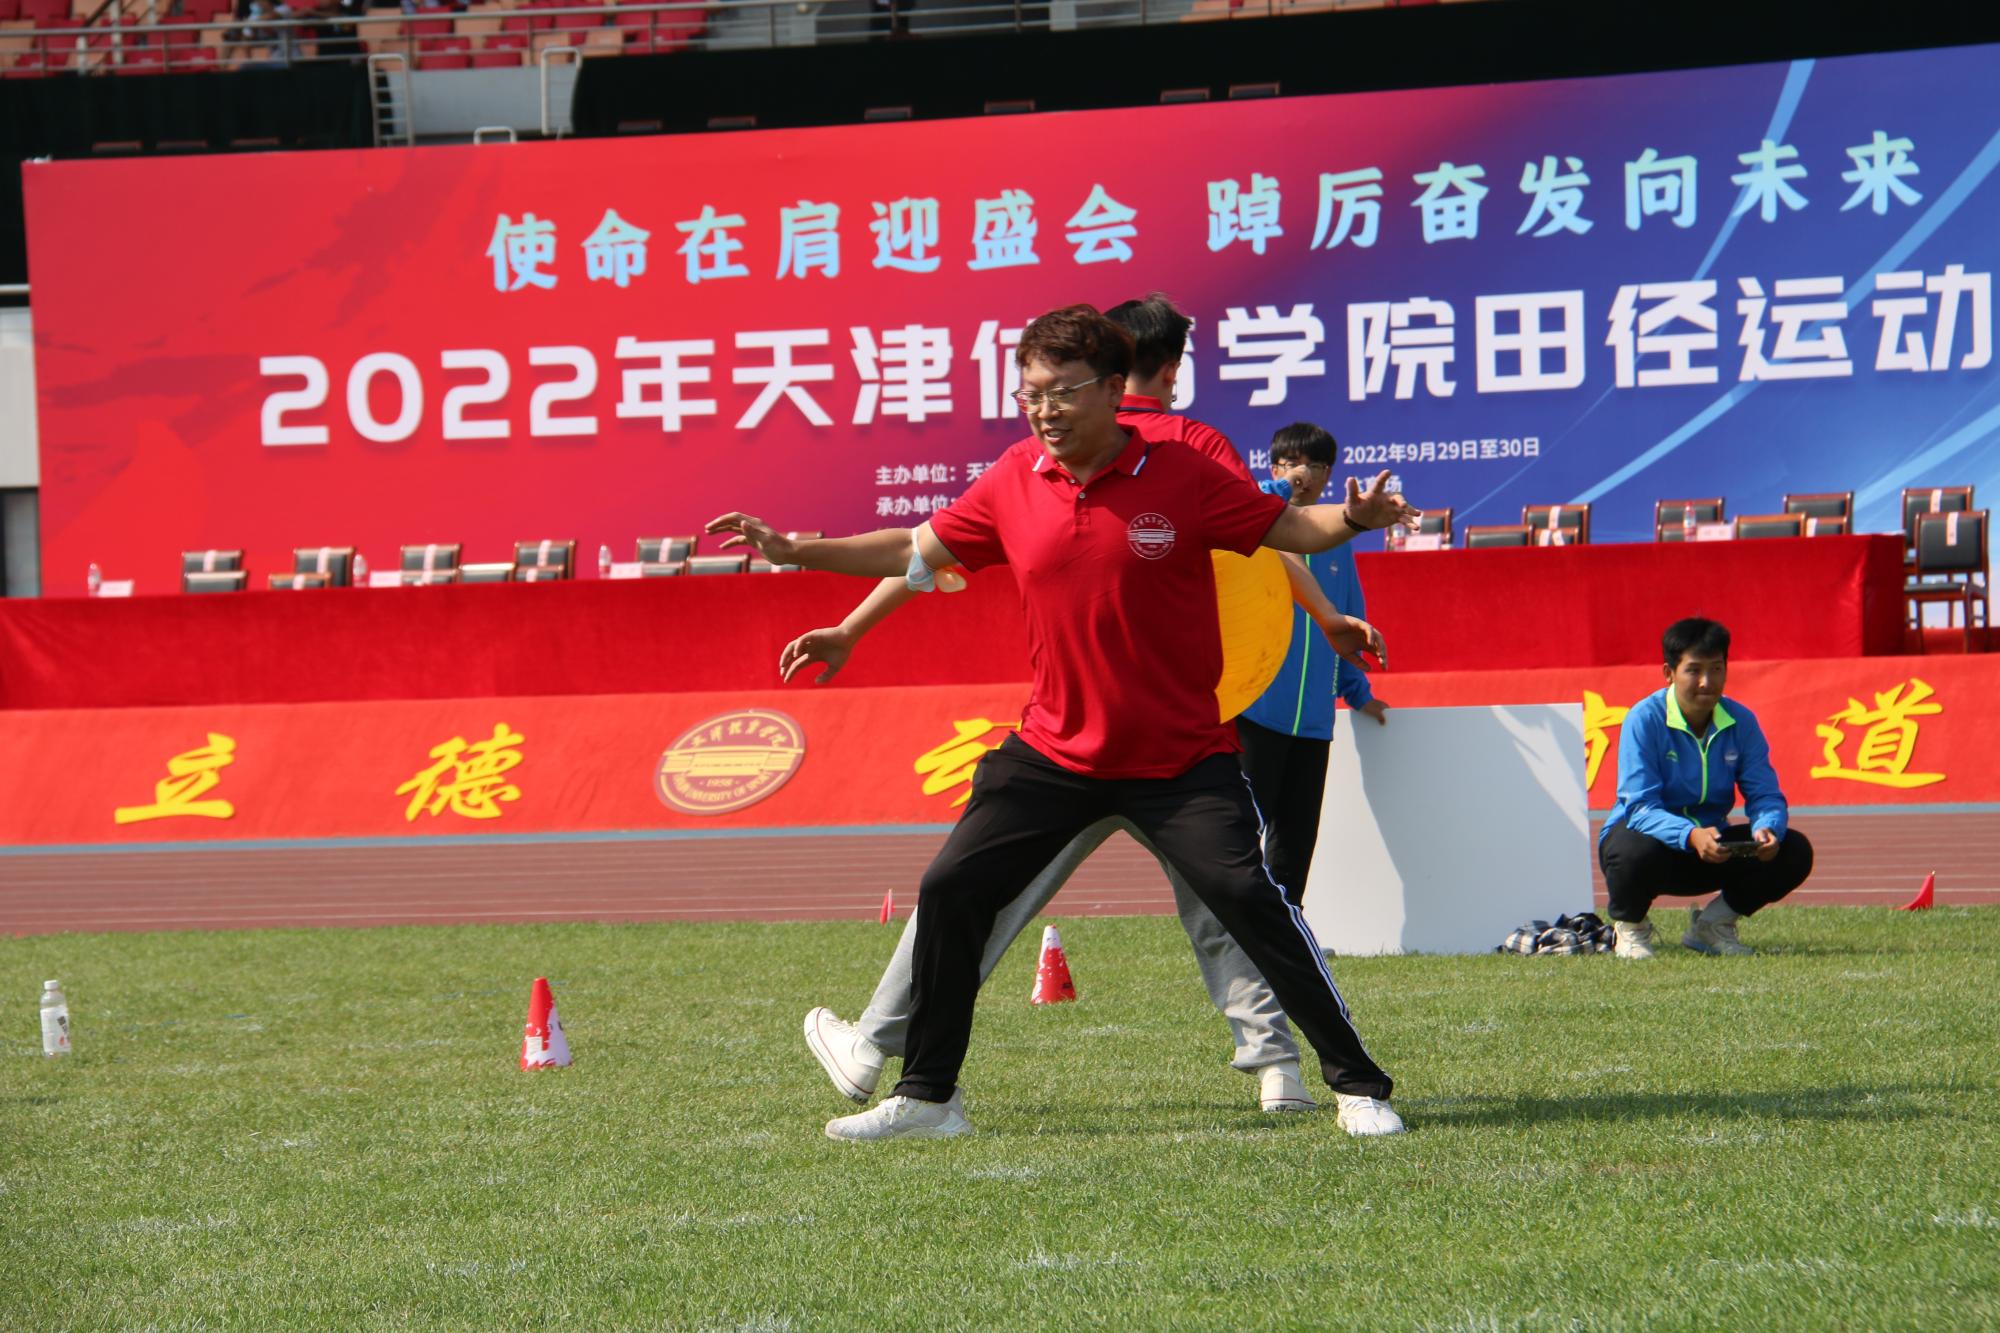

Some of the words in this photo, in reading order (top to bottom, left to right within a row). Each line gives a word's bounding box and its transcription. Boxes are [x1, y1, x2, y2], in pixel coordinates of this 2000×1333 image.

[487, 184, 1137, 292] 使命在肩迎盛会
[1207, 131, 1923, 255] 踔厉奋发向未来
[1343, 436, 1540, 464] 2022年9月29日至30日
[114, 732, 236, 824] 立
[395, 722, 525, 820] 德
[1810, 678, 1946, 788] 道
